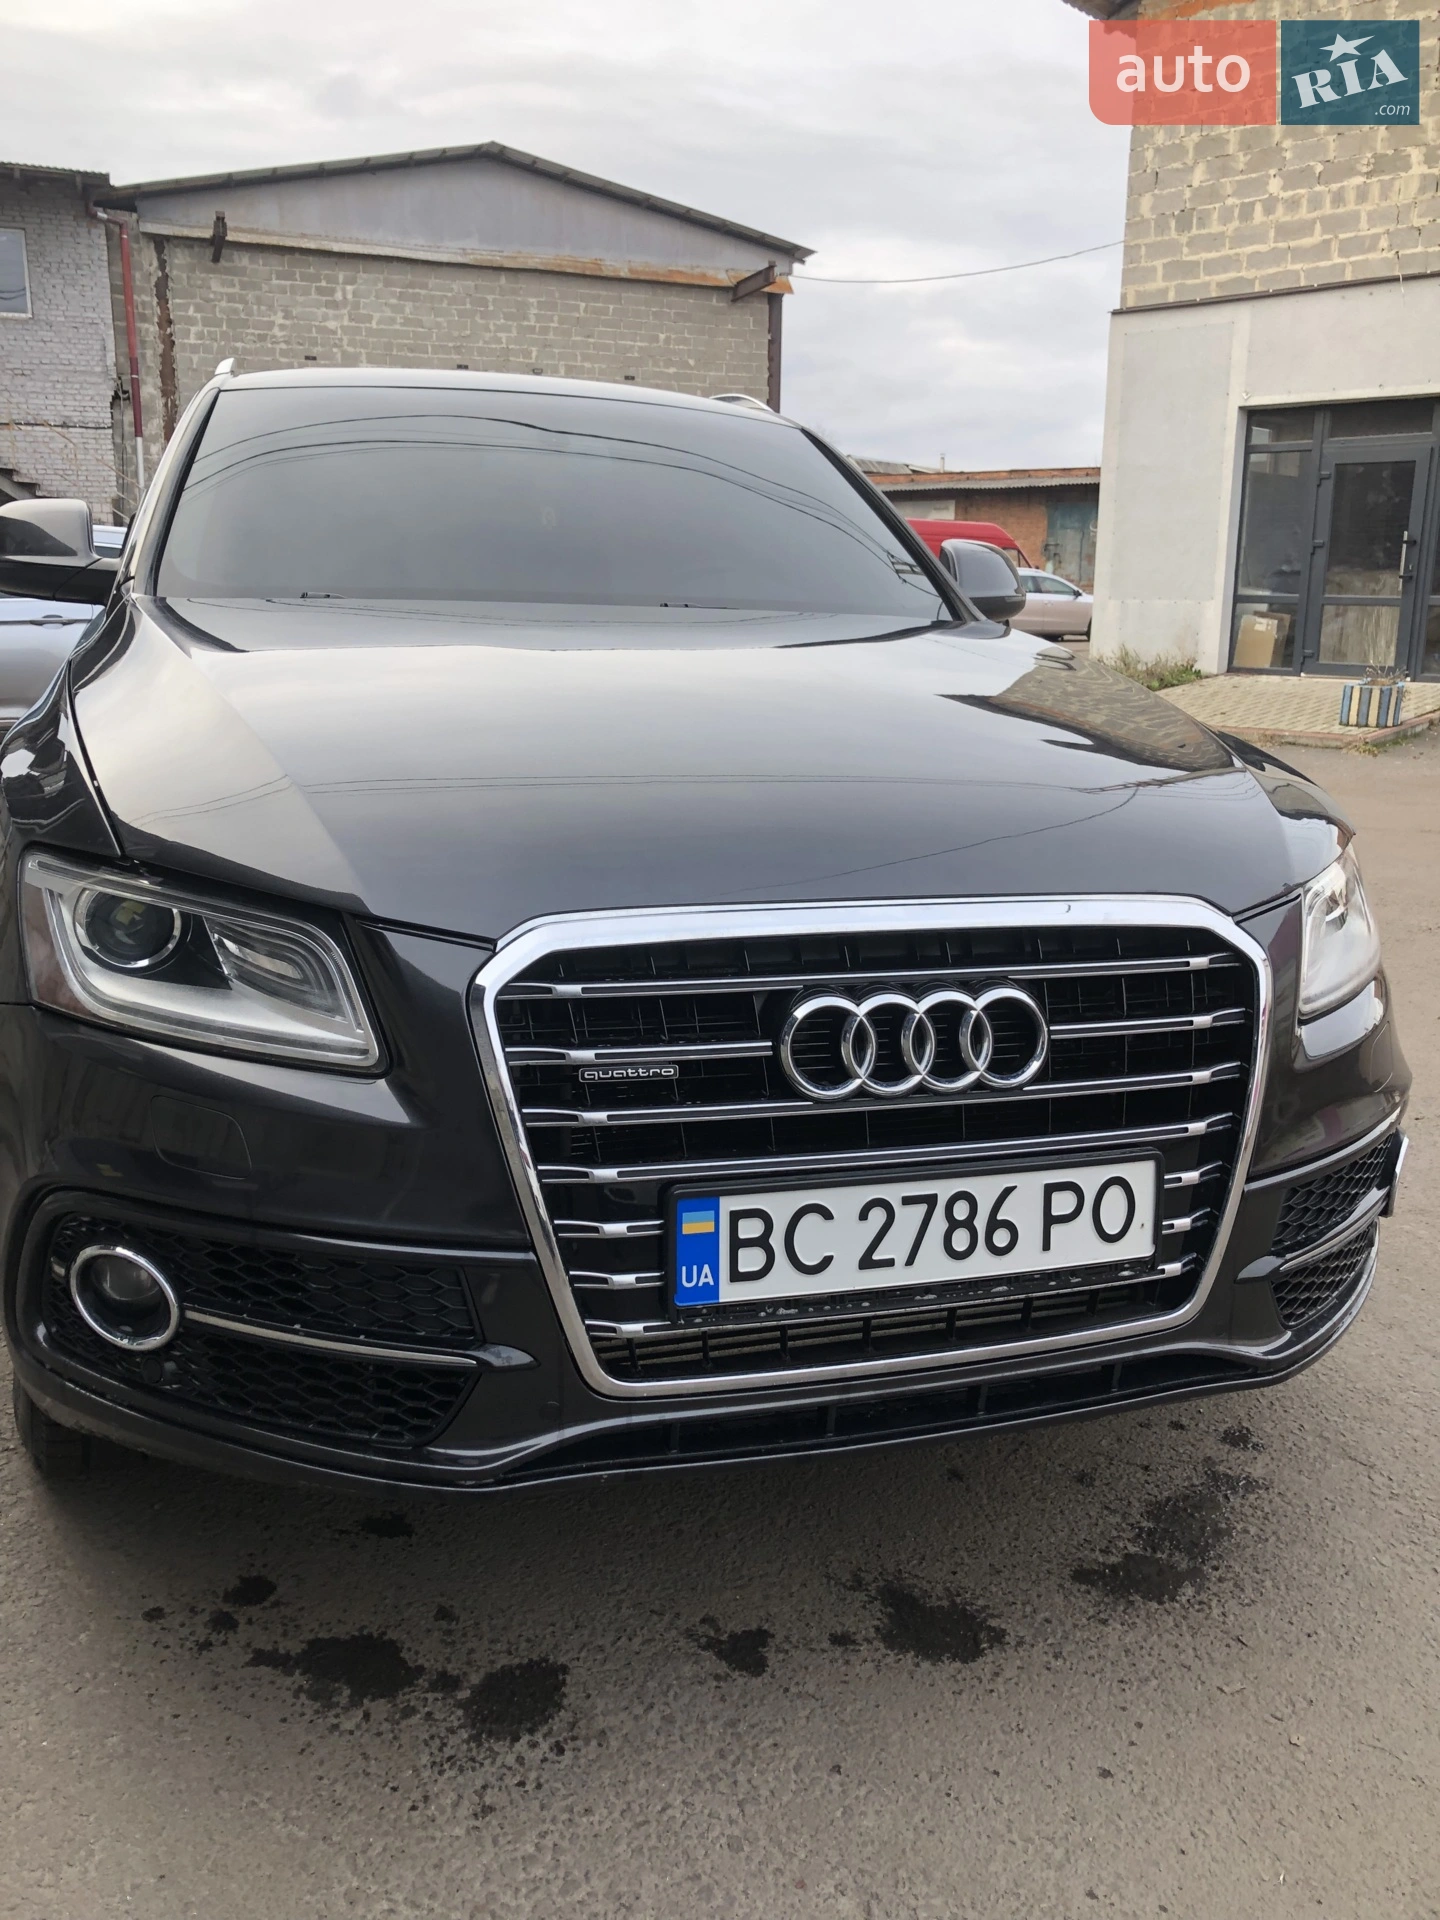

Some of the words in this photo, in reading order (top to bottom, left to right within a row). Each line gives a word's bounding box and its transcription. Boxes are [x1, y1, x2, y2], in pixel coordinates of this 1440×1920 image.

[584, 1067, 675, 1080] quattro
[728, 1202, 835, 1283] BC
[857, 1185, 1020, 1271] 2786
[1042, 1175, 1136, 1252] PO
[681, 1264, 715, 1288] UA
